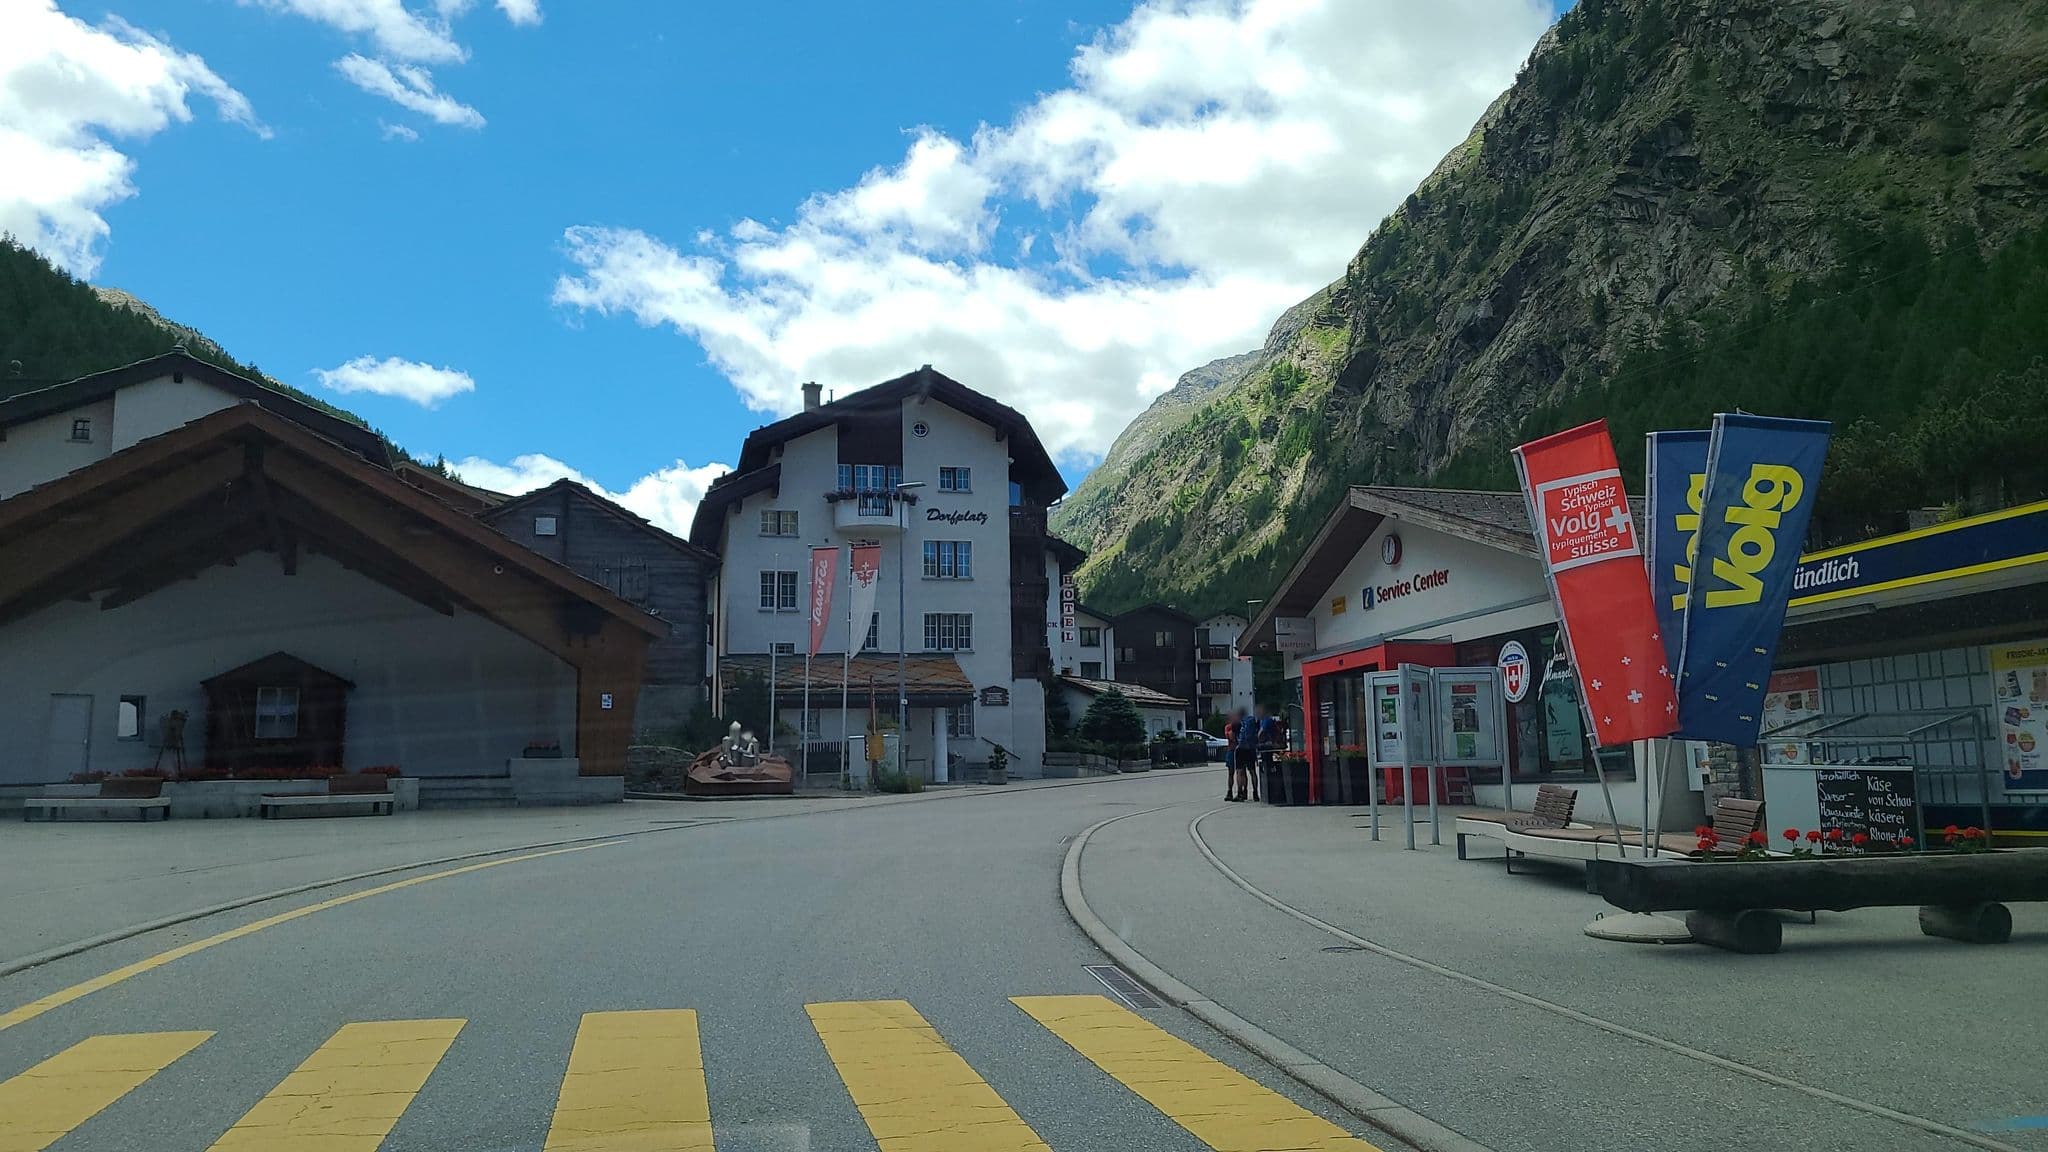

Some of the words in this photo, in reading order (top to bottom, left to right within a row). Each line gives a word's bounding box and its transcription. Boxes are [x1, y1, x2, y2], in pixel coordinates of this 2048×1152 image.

[1561, 485, 1617, 511] Schweiz
[1563, 480, 1598, 498] Typisch
[1584, 499, 1614, 512] Typisch
[926, 508, 988, 525] Dorfplatz
[1551, 511, 1601, 537] Volg
[1552, 530, 1607, 550] typiquement
[1706, 464, 1804, 608] Volg
[1571, 537, 1618, 558] suisse
[1376, 580, 1411, 603] Service
[1413, 569, 1449, 593] Center
[1064, 575, 1075, 641] HOTEL
[1867, 775, 1892, 791] Käse
[1868, 795, 1884, 806] von
[1869, 809, 1905, 824] käserei
[1870, 826, 1896, 841] Rhone
